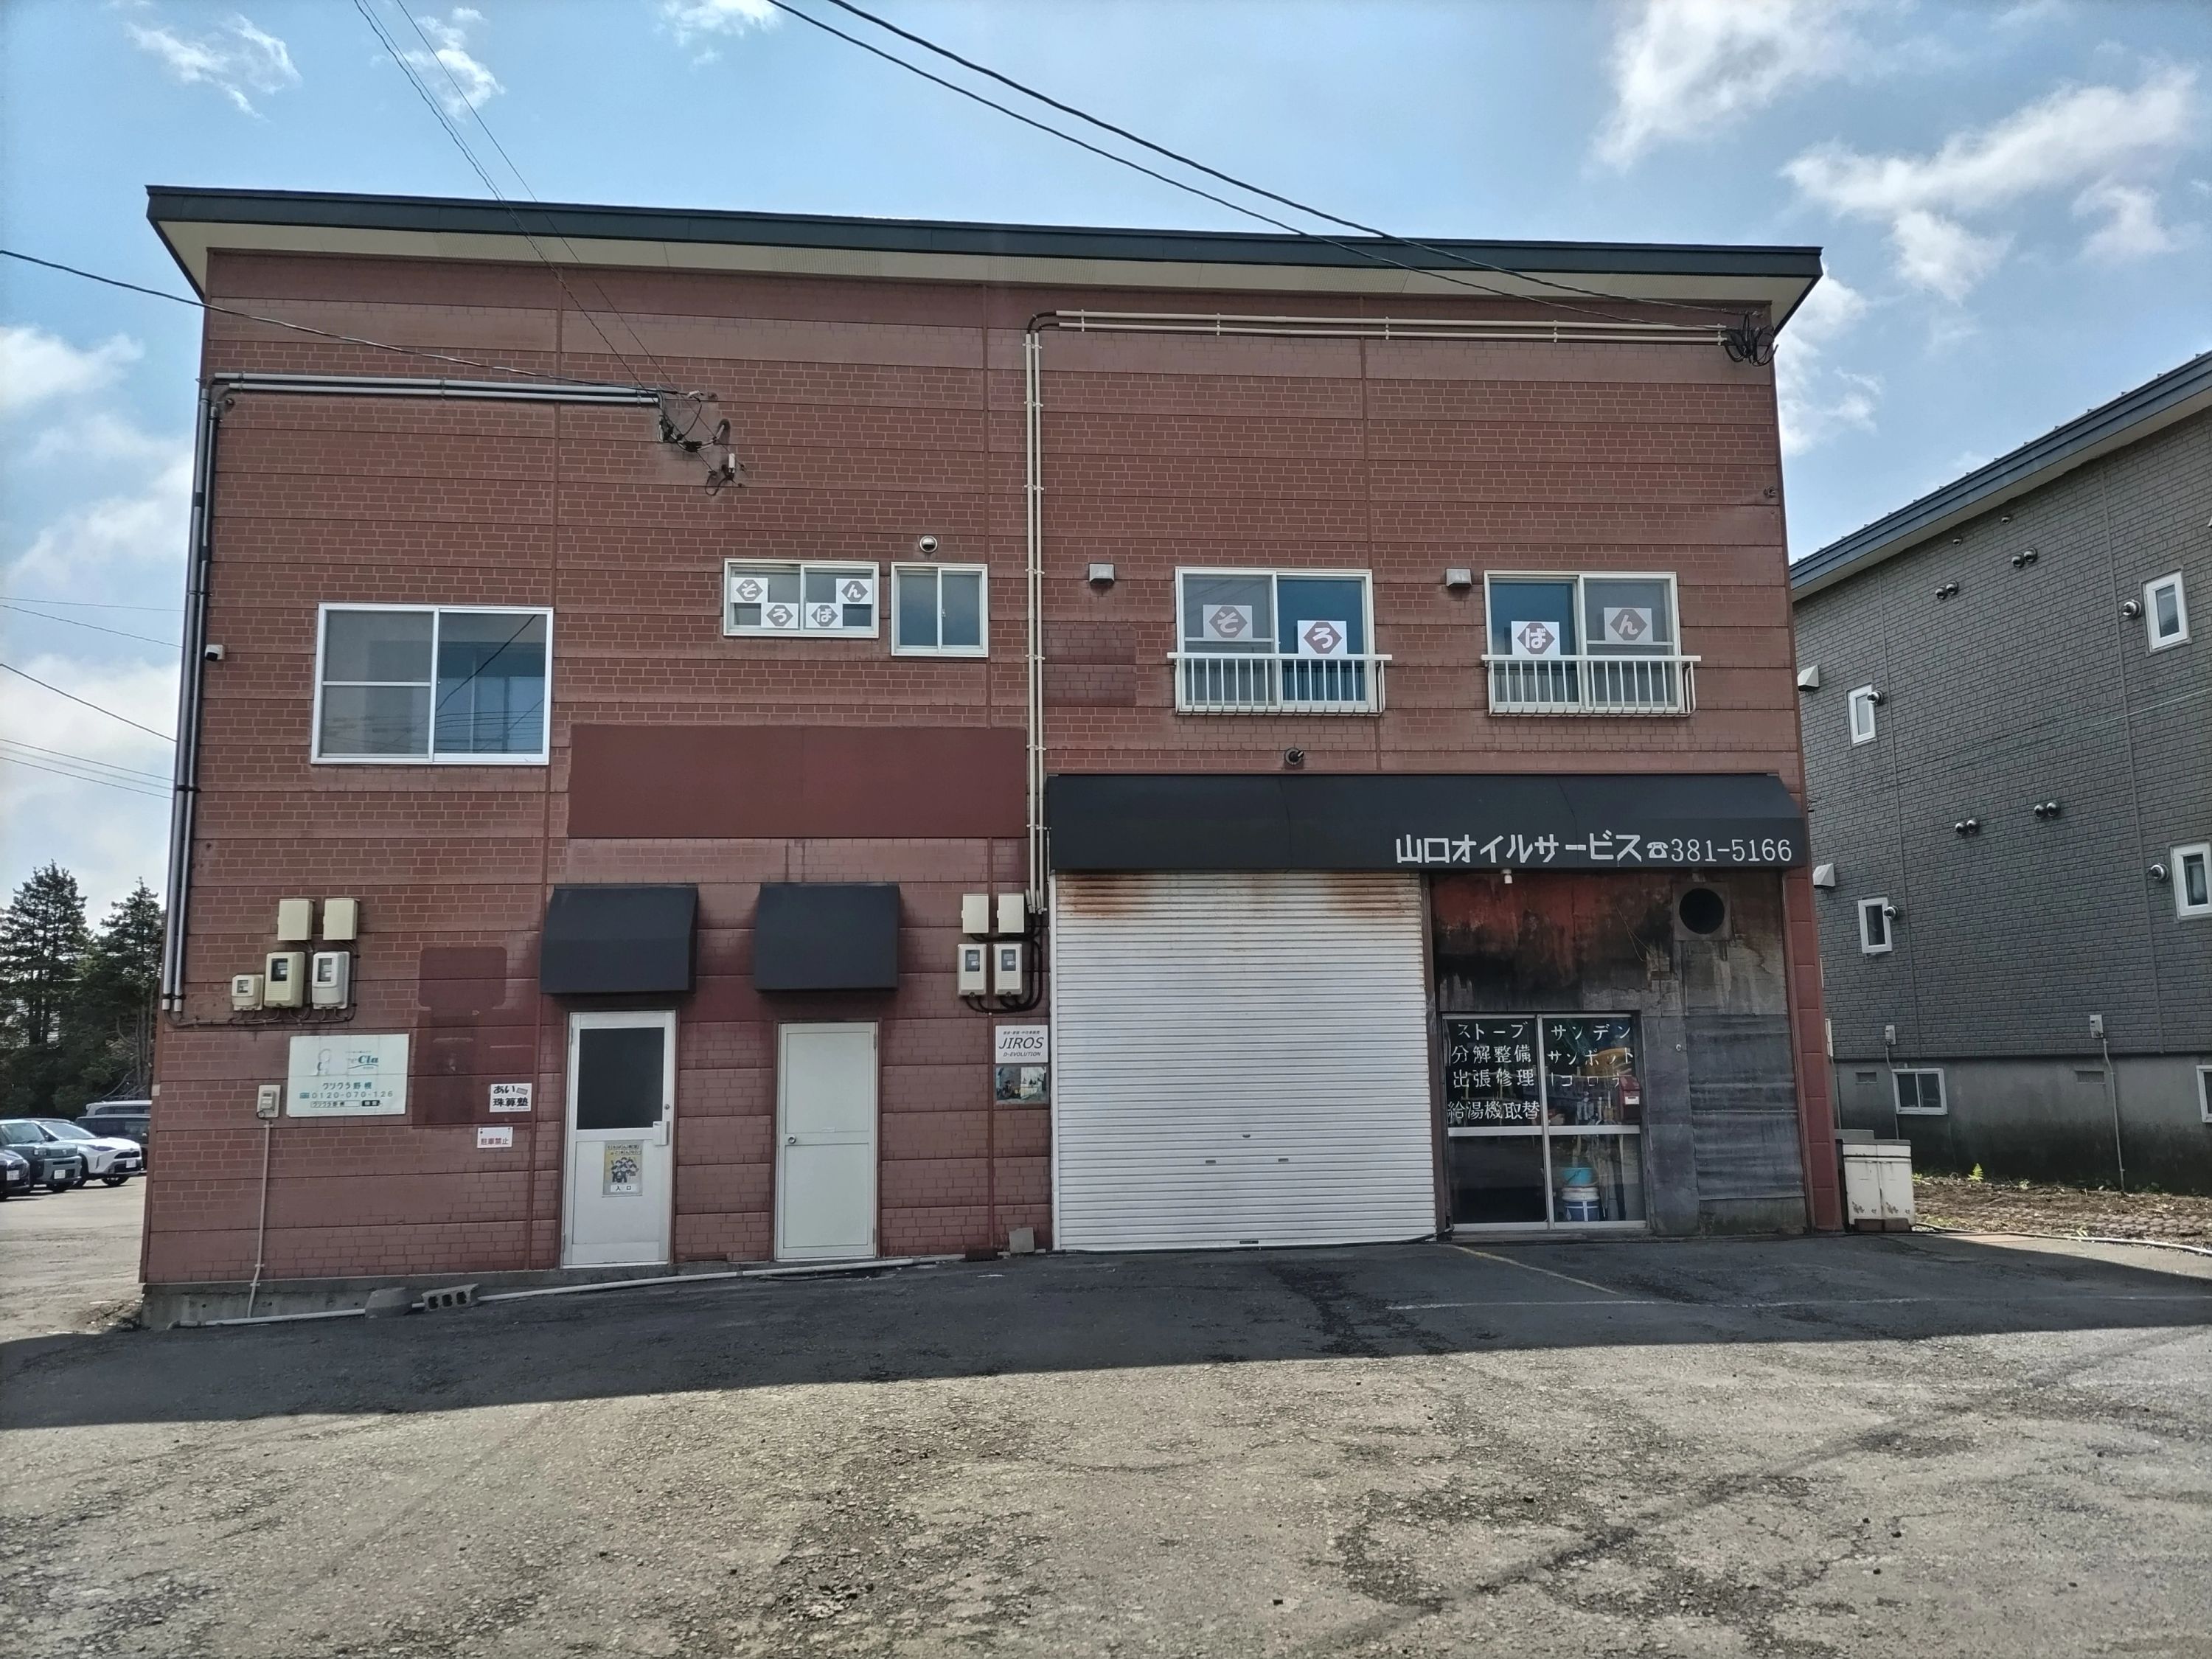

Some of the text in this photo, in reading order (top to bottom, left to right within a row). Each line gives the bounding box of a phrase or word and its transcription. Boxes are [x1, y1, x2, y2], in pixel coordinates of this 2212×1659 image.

[1396, 830, 1792, 863] 山口オイルサービス 381-5166
[1457, 1021, 1528, 1041] ストーブ
[1551, 1023, 1631, 1041] サンデン
[998, 1037, 1044, 1049] JIROS
[1451, 1044, 1531, 1064] 分解整備
[1453, 1068, 1534, 1088] 出張修理
[311, 1091, 393, 1099] 0120-070-126
[493, 1085, 515, 1094] あい
[493, 1096, 529, 1107] 珠算塾
[1447, 1100, 1540, 1120] 給湯機取替
